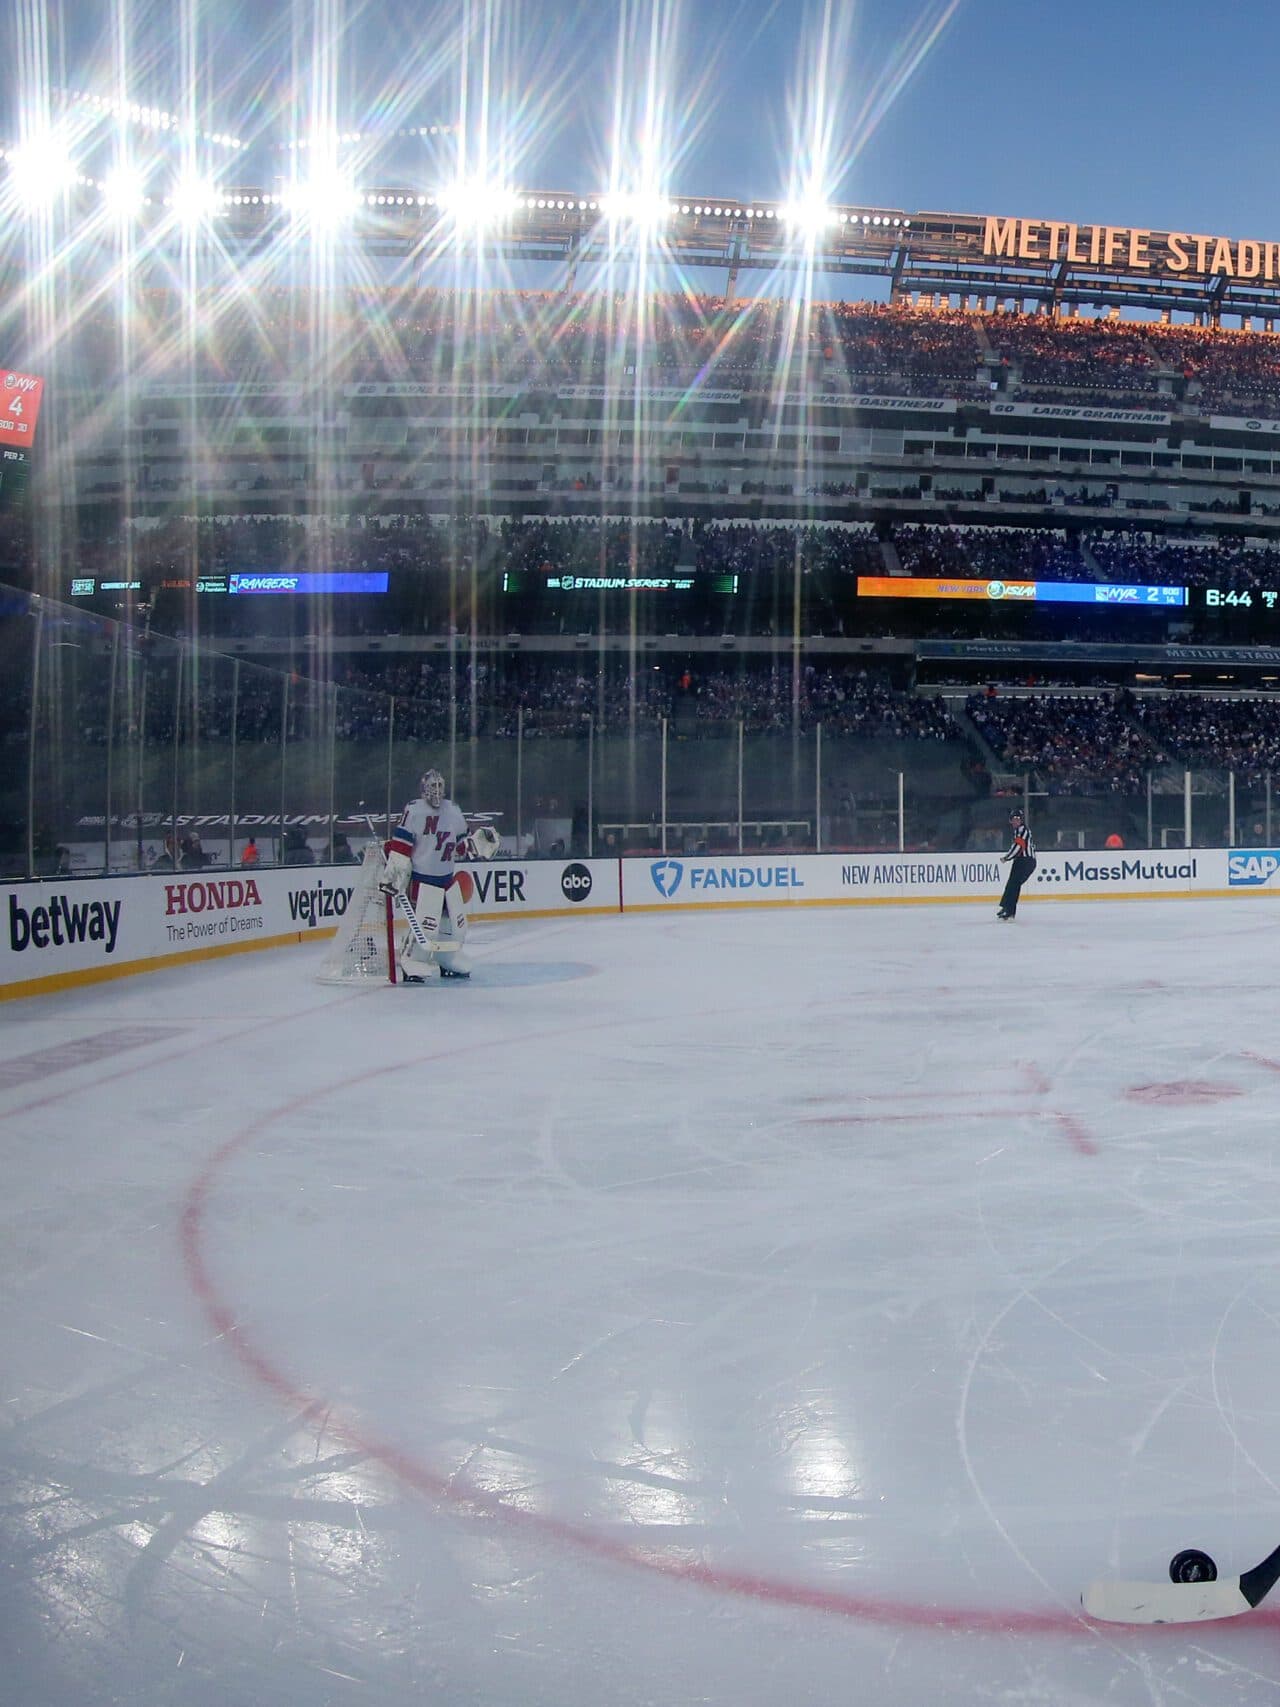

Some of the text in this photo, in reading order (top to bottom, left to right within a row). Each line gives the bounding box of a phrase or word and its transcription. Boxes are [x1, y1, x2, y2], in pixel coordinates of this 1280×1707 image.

[983, 216, 1150, 268] METLIFE
[9, 396, 23, 416] 4
[1032, 407, 1080, 417] LARRY
[1082, 410, 1166, 423] GRANTHAM
[4, 451, 18, 460] PER
[239, 577, 298, 590] RANGERS
[574, 578, 670, 588] STADIUM SERIES
[1109, 587, 1159, 602] NYR 2
[1206, 589, 1252, 607] 6:44
[1266, 599, 1274, 608] 2
[1166, 650, 1233, 660] METLIFE
[161, 814, 336, 827] STADIUM
[842, 864, 1000, 885] NEW AMSTERDAM VODKA
[1065, 859, 1197, 882] MassMutual
[1229, 856, 1278, 880] SAP
[563, 874, 591, 890] abc
[691, 867, 804, 889] FANDUEL
[164, 879, 263, 916] HONDA
[9, 894, 121, 953] betway
[166, 915, 263, 941] The Power of Dreams
